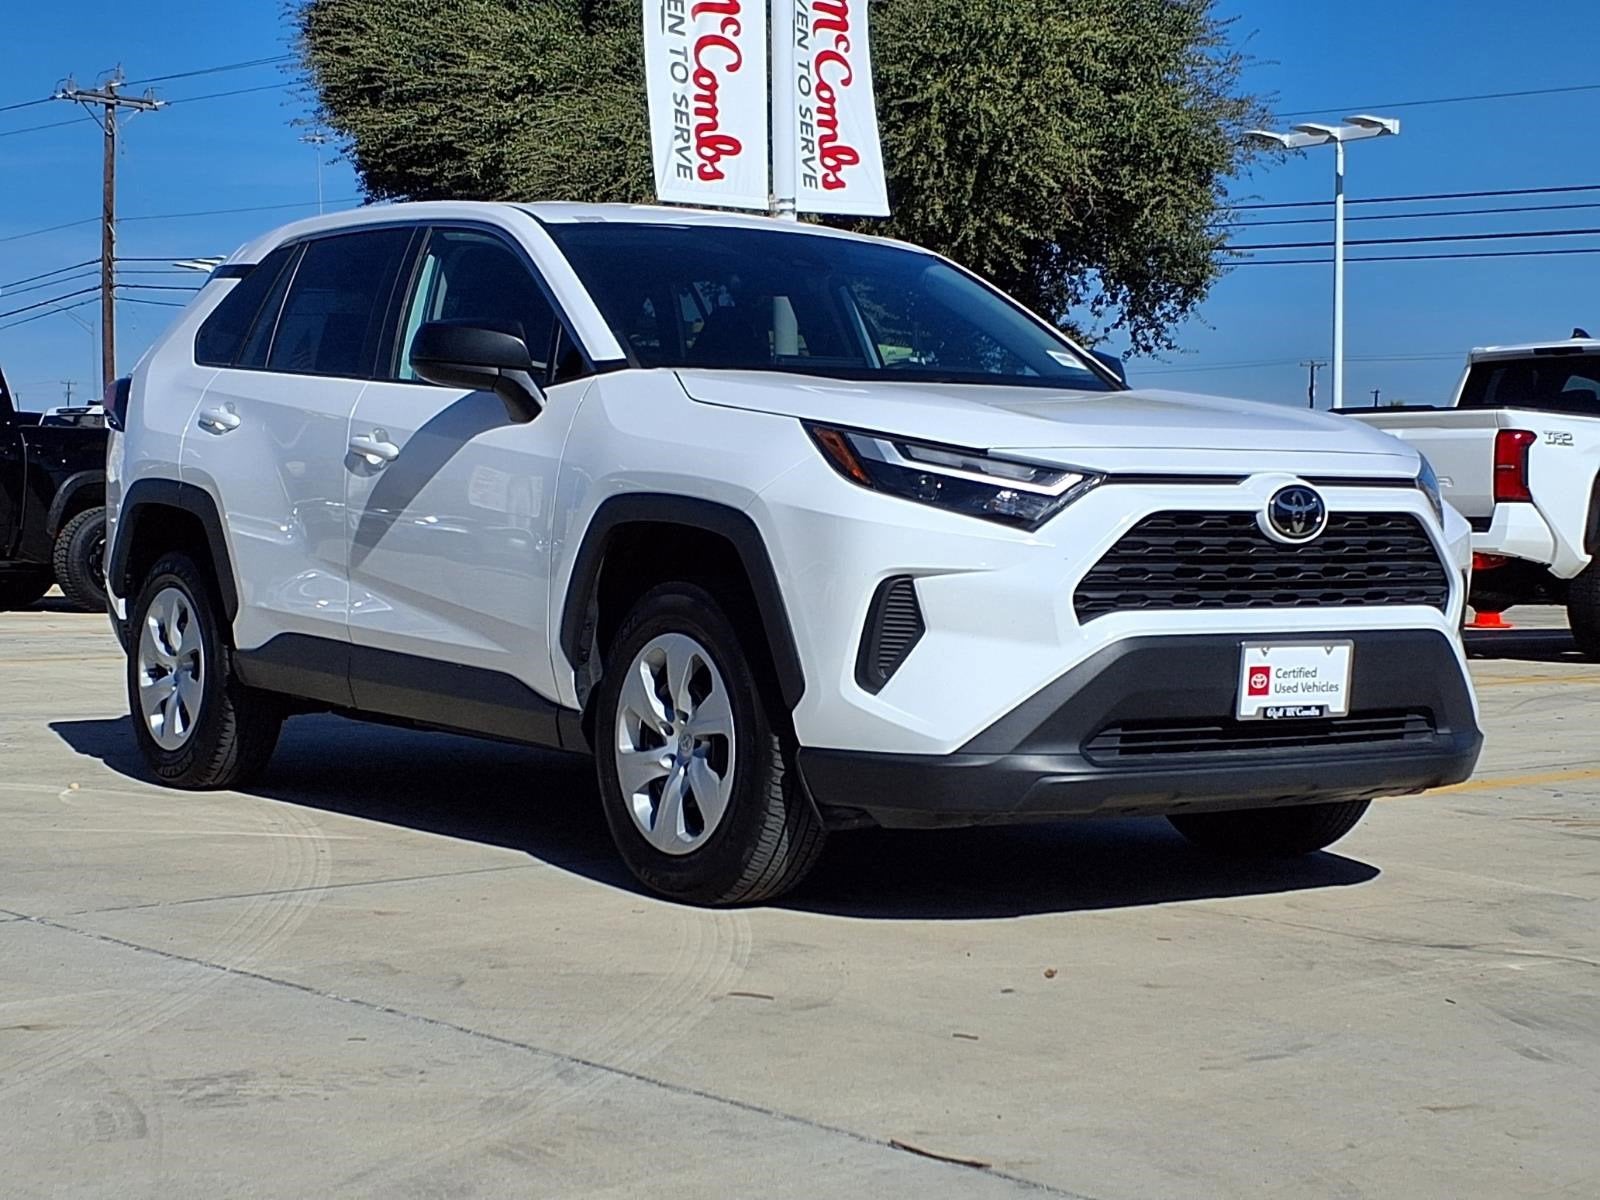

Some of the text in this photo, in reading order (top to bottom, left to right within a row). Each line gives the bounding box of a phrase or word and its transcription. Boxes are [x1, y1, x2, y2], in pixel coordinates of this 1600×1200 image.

[669, 46, 690, 84] TO
[797, 60, 811, 97] TO
[672, 92, 693, 180] SERVE
[799, 104, 818, 190] SERVE
[1274, 681, 1339, 694] Used Vehicles
[1275, 667, 1317, 678] Certified
